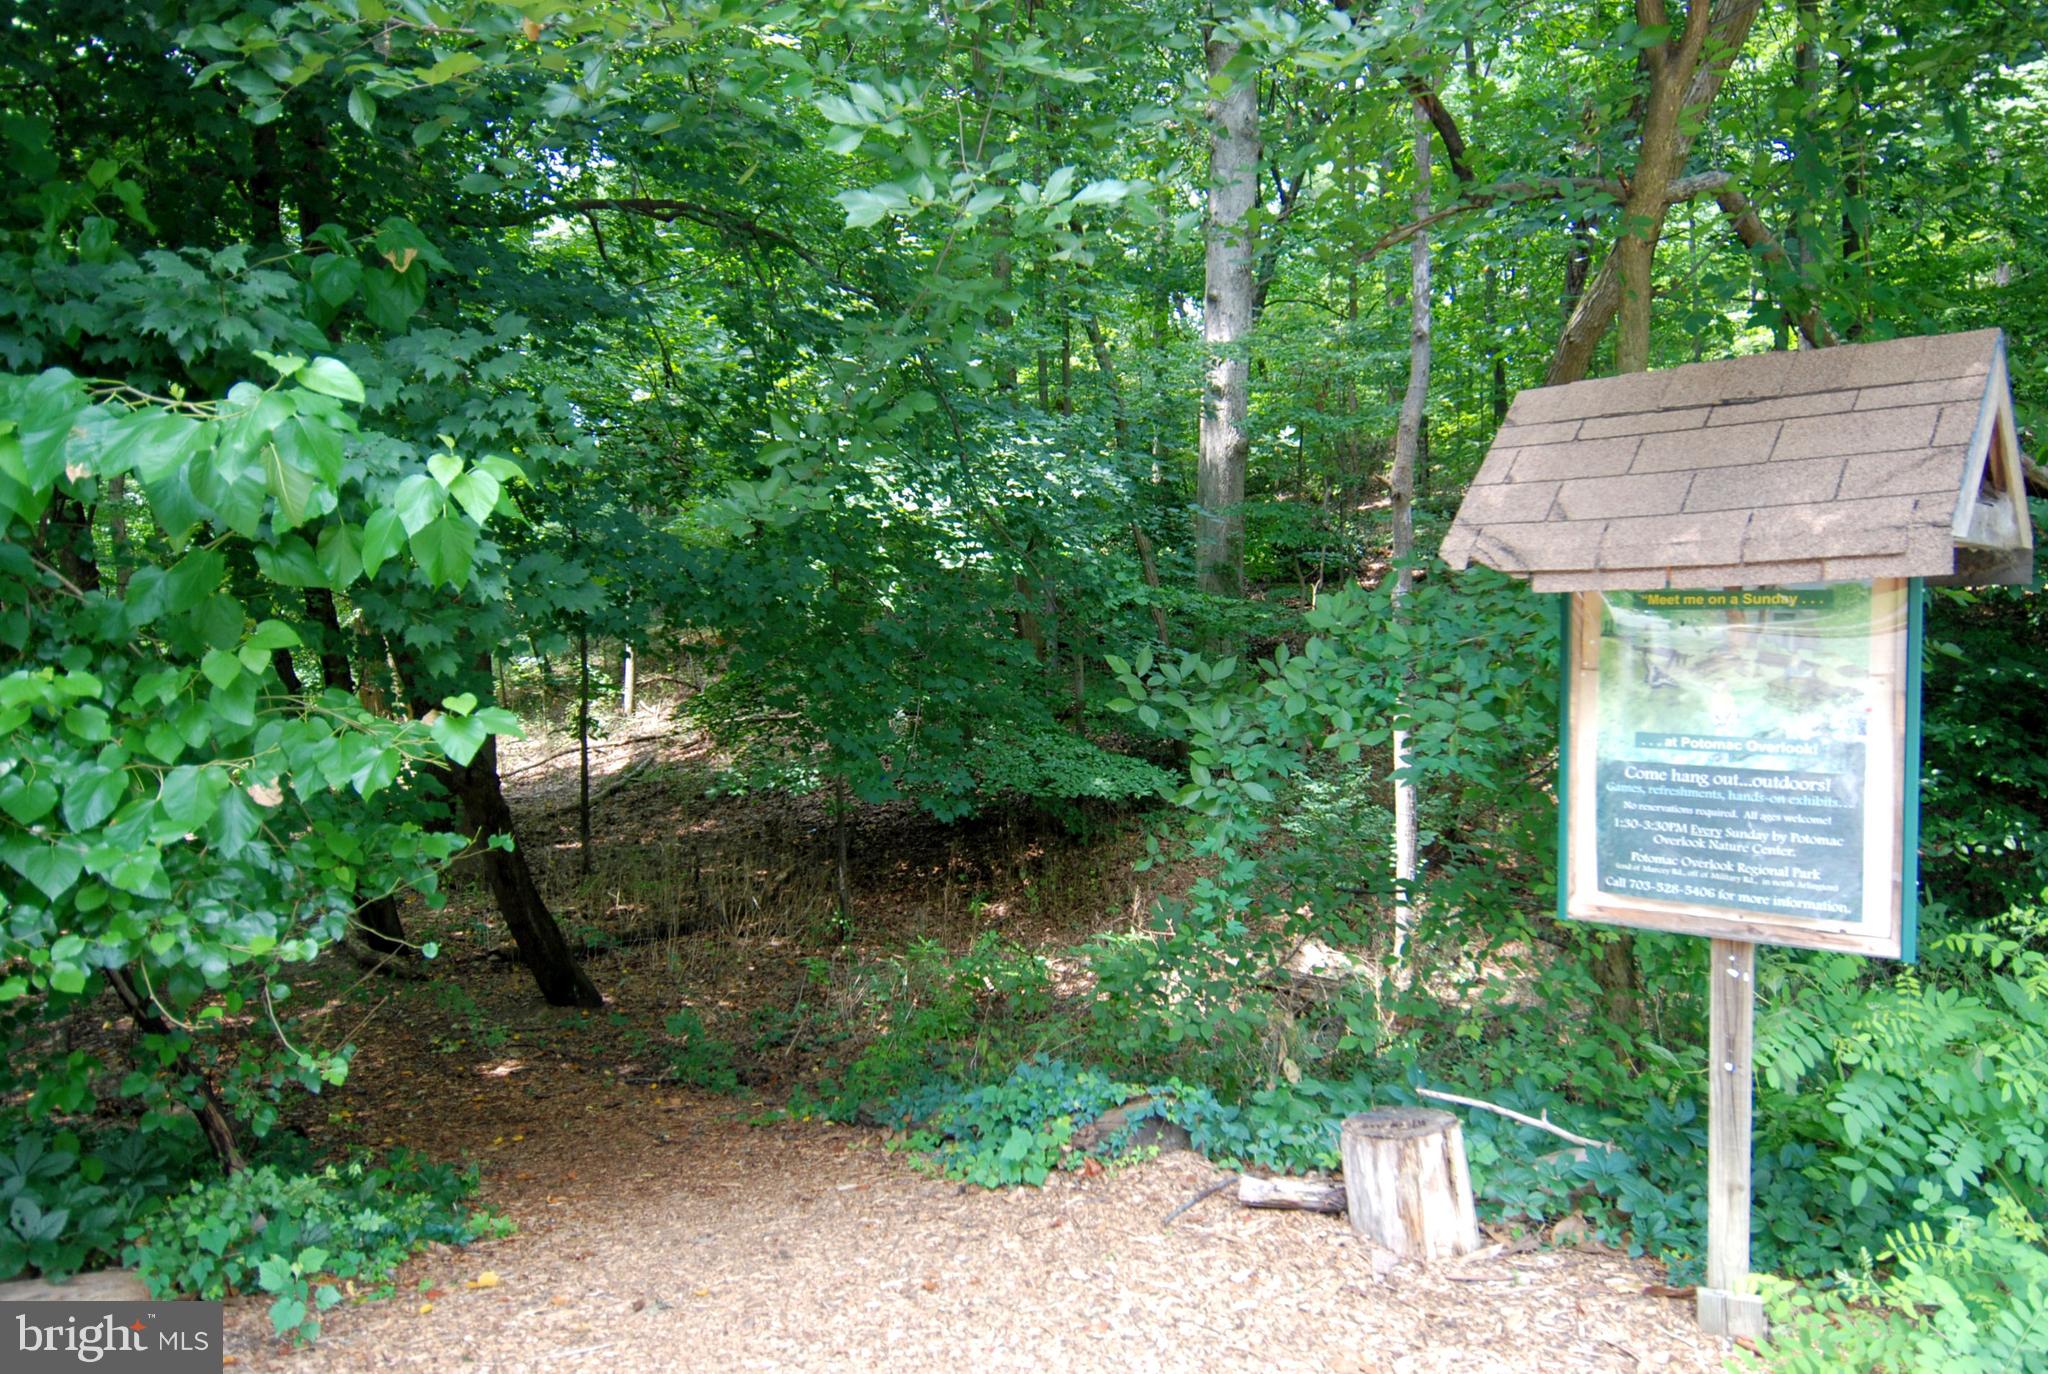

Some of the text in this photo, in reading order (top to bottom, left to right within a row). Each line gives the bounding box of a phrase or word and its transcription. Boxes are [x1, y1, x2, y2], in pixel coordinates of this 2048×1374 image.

[1683, 595, 1704, 605] me
[1708, 594, 1726, 605] on
[1729, 595, 1738, 605] a
[1743, 593, 1797, 607] Sunday
[1664, 737, 1677, 747] at
[1681, 736, 1742, 751] Potomac
[1746, 740, 1818, 755] Overlook!
[1624, 766, 1667, 781] Come
[1671, 768, 1710, 787] hang
[1606, 782, 1646, 794] Games,
[1648, 785, 1726, 800] refreshments,
[1728, 790, 1785, 804] hands-on
[1623, 801, 1832, 825] No reservations required. All ages welcome!
[1614, 818, 1845, 847] 1:30-3:30PM Every Sunday by Potomac
[1653, 834, 1797, 857] Overlook Nature Center.
[1631, 852, 1821, 880] Potomac Overlook Regional Park
[1605, 877, 1852, 914] Call 703-528-5406 for more information.
